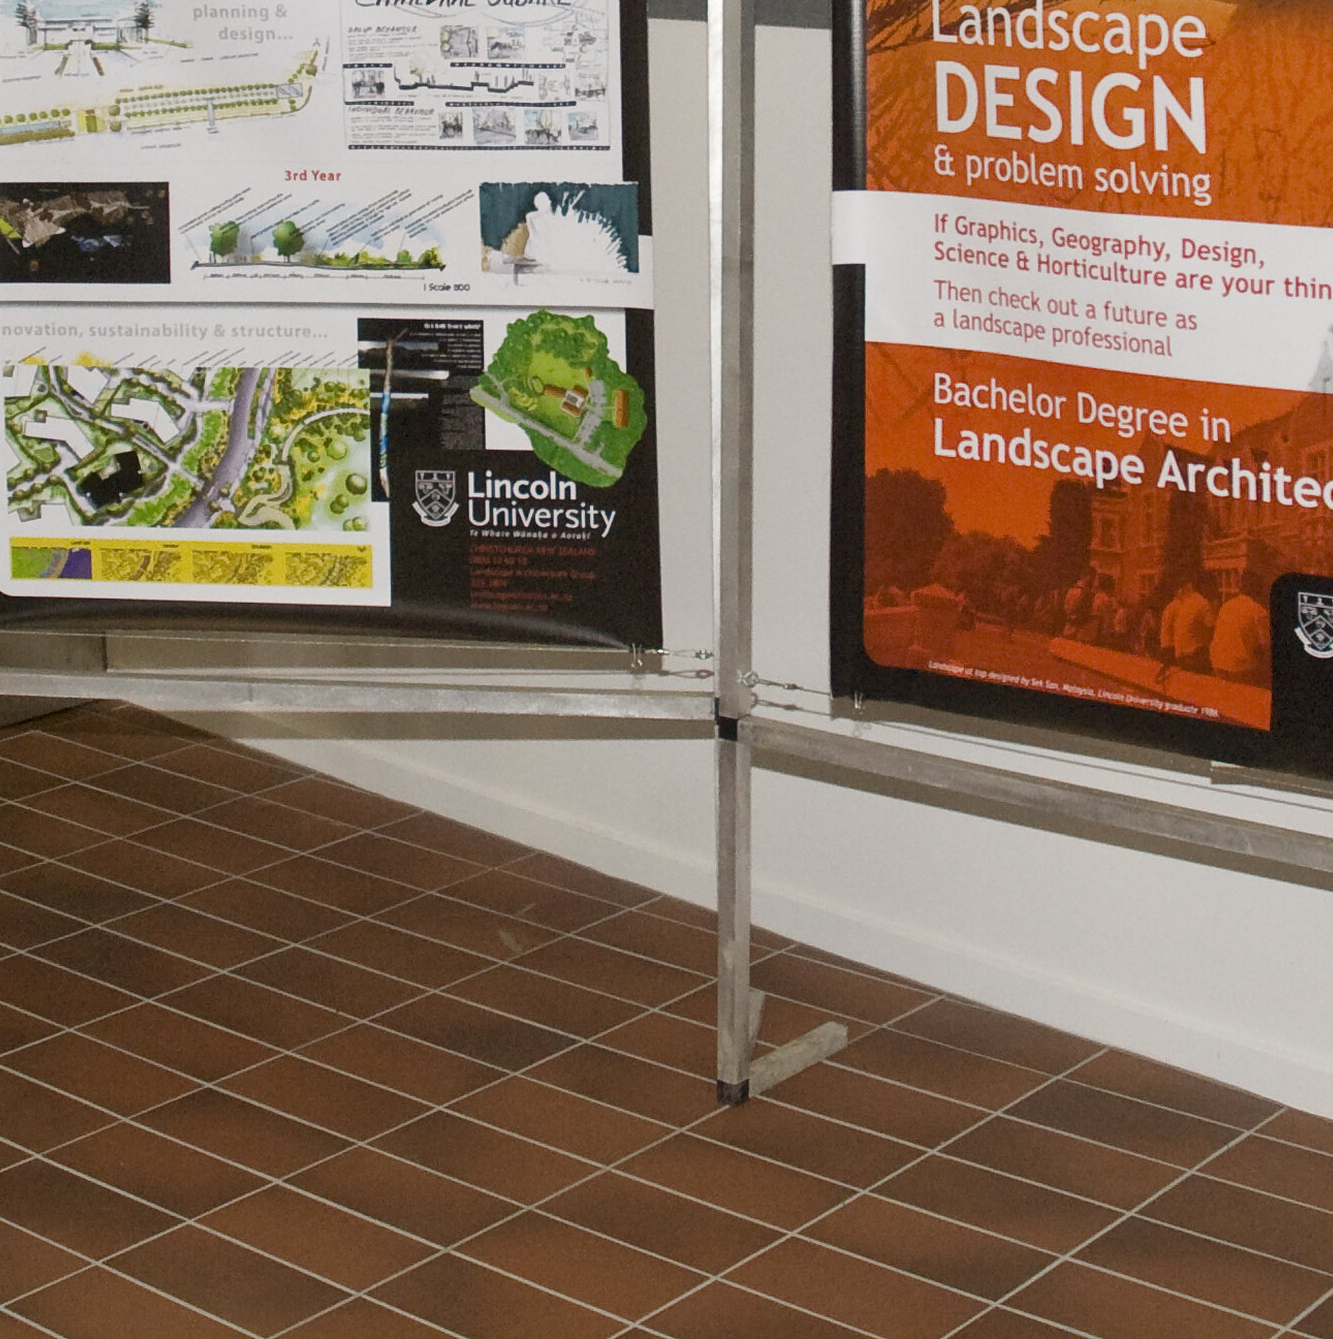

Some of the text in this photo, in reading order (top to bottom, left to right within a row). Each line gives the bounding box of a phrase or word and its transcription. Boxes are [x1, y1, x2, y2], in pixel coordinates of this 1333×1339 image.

[193, 5, 287, 21] planning &
[219, 26, 293, 44] design...
[936, 61, 1206, 153] DESIGN
[285, 171, 341, 181] 3rd Year
[934, 145, 1212, 206] & problem solving
[934, 213, 1264, 269] If Graphics, Geography, Design,
[934, 242, 1009, 267] Science
[1016, 251, 1029, 270] &
[1038, 253, 1166, 287] Horticulture
[1176, 272, 1212, 290] are
[1221, 275, 1275, 297] your
[934, 280, 1197, 331] Then check out a future as
[89, 323, 207, 340] sustainability
[213, 325, 225, 336] &
[231, 326, 327, 339] structure...
[934, 309, 1172, 356] a landscape professional
[934, 372, 1231, 443] Bachelor Degree in
[934, 418, 1144, 489] Landscape
[468, 470, 576, 500] Lincoln
[469, 499, 615, 537] University
